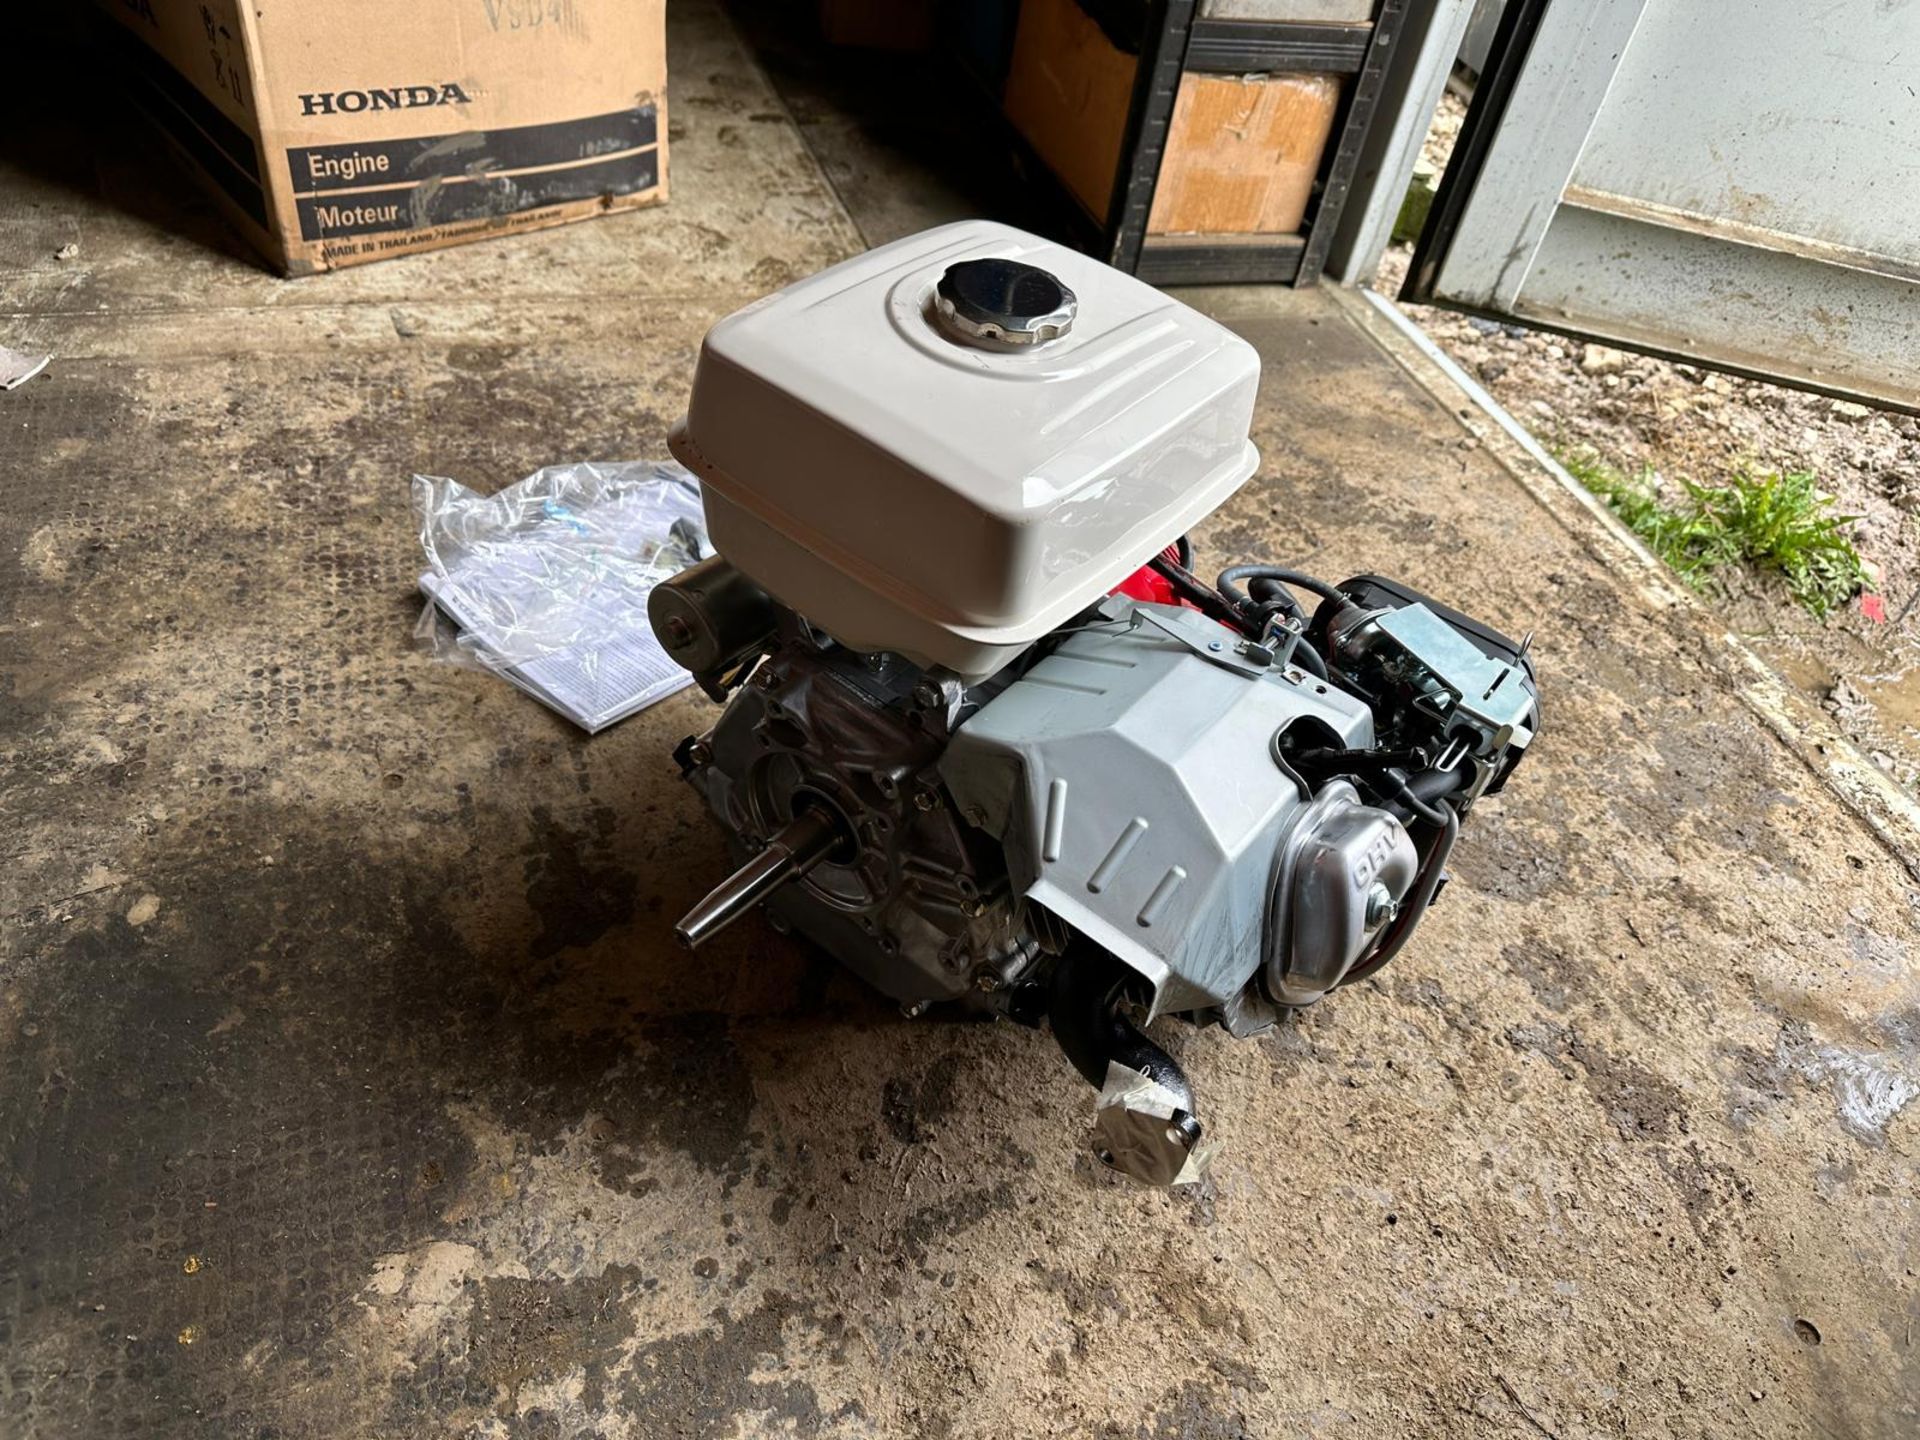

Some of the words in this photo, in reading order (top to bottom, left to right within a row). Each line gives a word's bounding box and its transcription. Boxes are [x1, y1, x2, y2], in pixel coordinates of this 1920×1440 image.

[298, 83, 472, 117] HONDA
[307, 151, 390, 181] Engine
[317, 203, 399, 229] Moteur
[325, 243, 359, 259] MADE
[361, 242, 376, 254] IN
[1351, 820, 1400, 890] OHV
